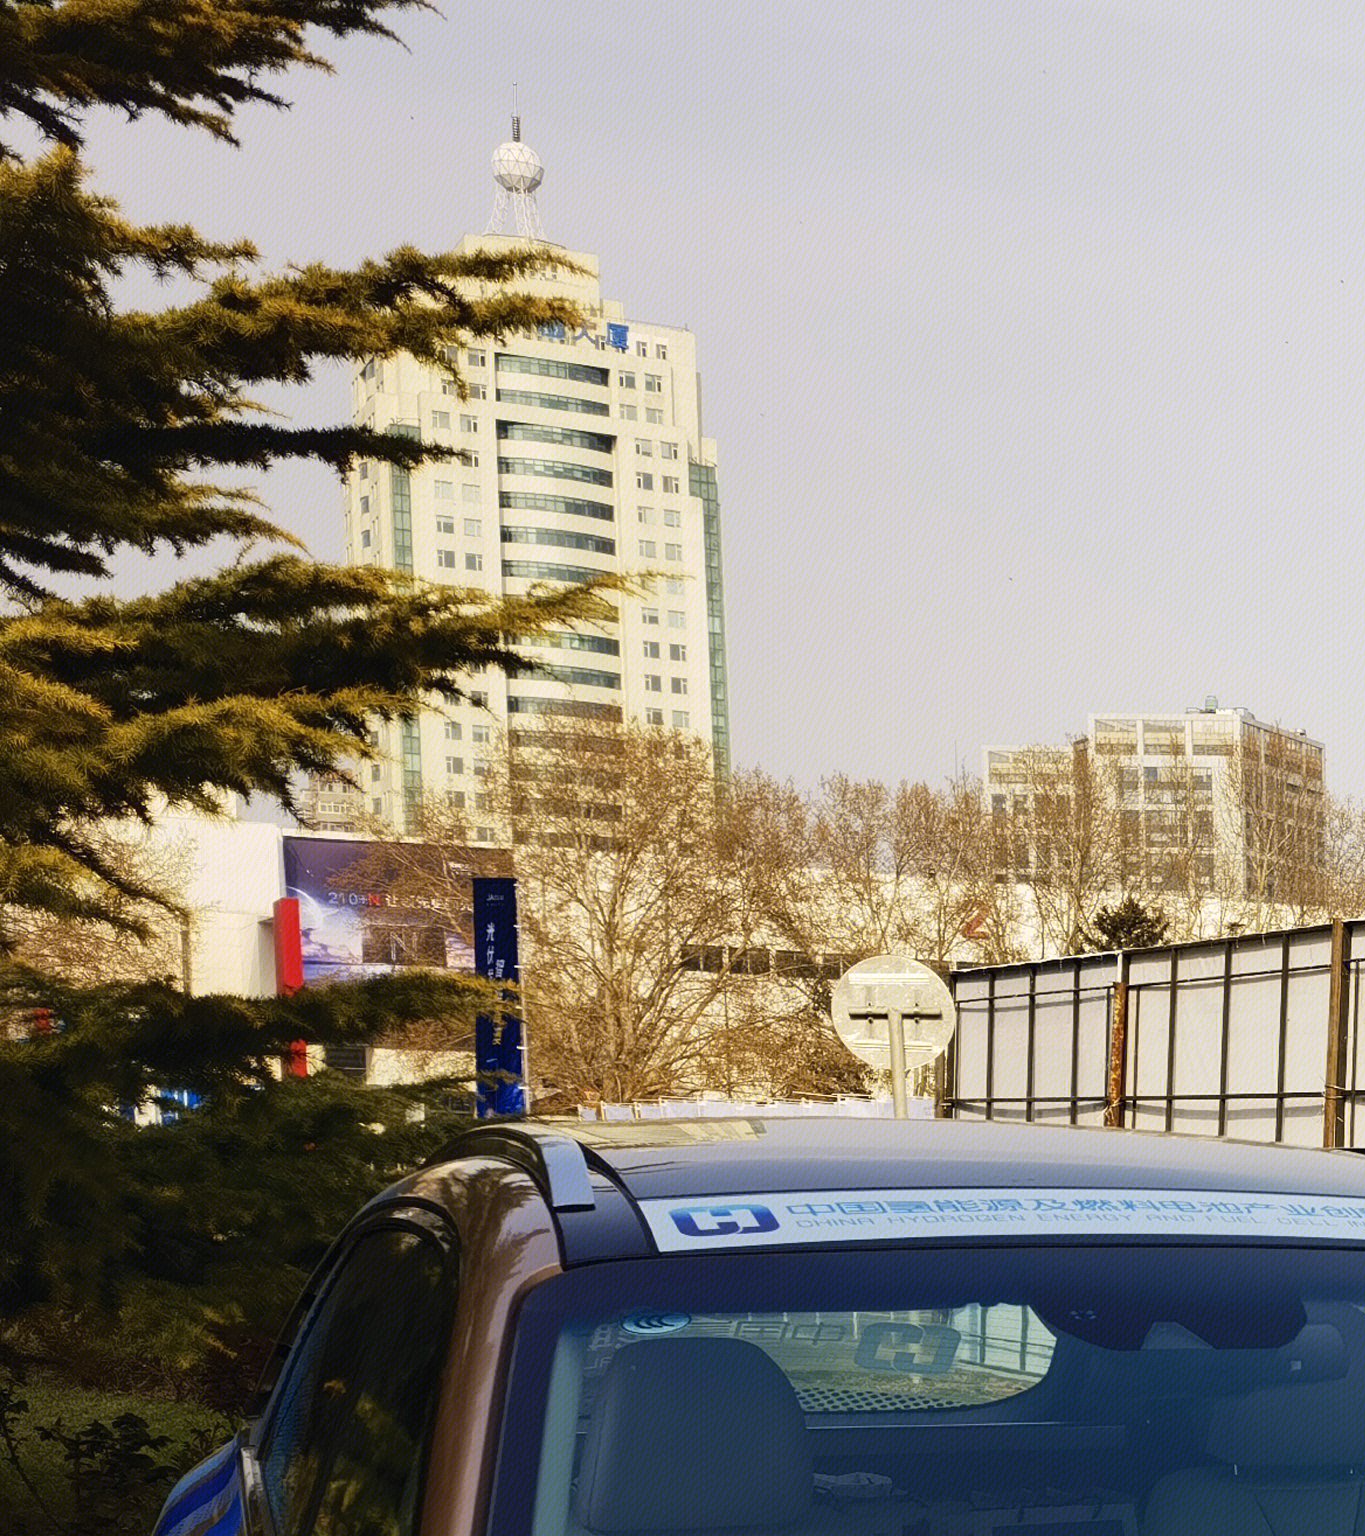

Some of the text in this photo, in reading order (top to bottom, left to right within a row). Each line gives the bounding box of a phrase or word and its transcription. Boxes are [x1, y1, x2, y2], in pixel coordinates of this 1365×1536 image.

[796, 1217, 874, 1229] CHINA
[886, 1213, 1026, 1226] HYDROGEN
[1038, 1213, 1132, 1223] ENERGY
[1146, 1213, 1196, 1223] AND
[1206, 1214, 1270, 1225] FUEL
[1277, 1216, 1338, 1228] CELL
